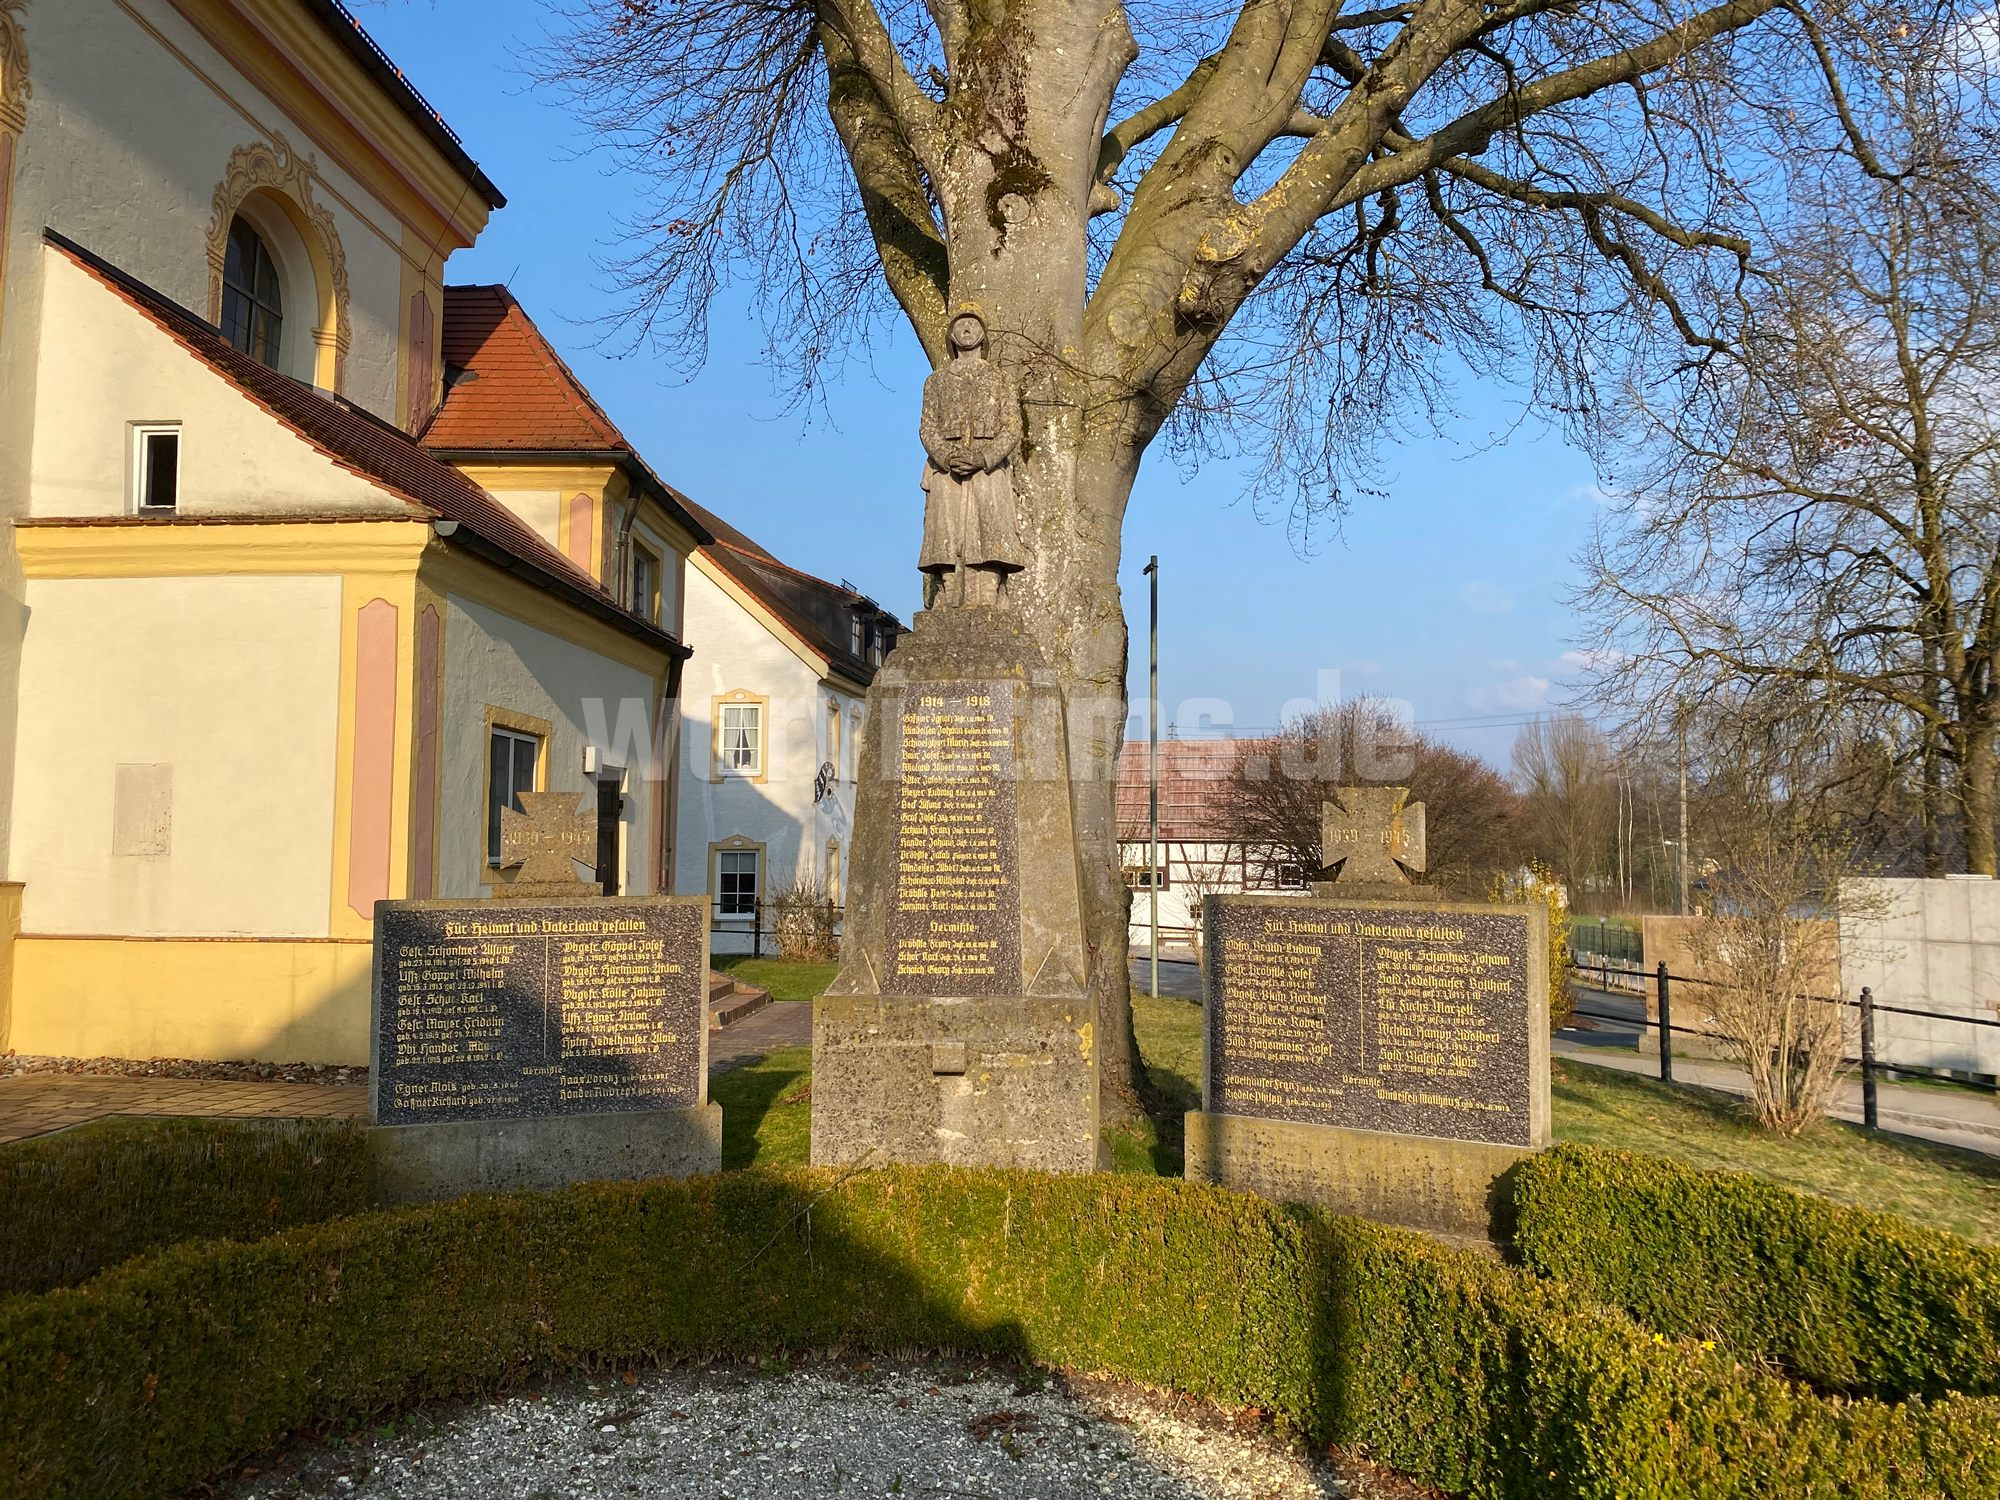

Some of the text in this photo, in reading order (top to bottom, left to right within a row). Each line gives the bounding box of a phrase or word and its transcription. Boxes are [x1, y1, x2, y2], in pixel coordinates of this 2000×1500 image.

[920, 696, 944, 707] 1914
[965, 696, 991, 707] 1918
[937, 725, 963, 736] Johann
[445, 919, 647, 937] Für Heimat und Vaterland gefallen
[1264, 920, 1463, 941] Für Heimat und Vaterland gefallen
[481, 943, 515, 956] Alfons
[639, 939, 665, 953] Josef
[1285, 943, 1322, 956] Ludwig
[1472, 952, 1510, 967] Johann
[463, 968, 504, 980] Wilhelm
[601, 965, 650, 977] Hartmann
[651, 962, 682, 974] Anton
[1288, 967, 1312, 980] Josef
[460, 992, 483, 1004] Karl
[630, 987, 666, 1000] Johann
[426, 1018, 460, 1031] Mayer
[464, 1016, 504, 1030] Fridolin
[585, 1012, 615, 1024] Egner
[618, 1010, 647, 1021] Anton
[650, 1032, 677, 1043] Alois
[1309, 1042, 1333, 1056] Josef
[394, 1081, 457, 1096] Egner Alois
[432, 1096, 467, 1108] Richard
